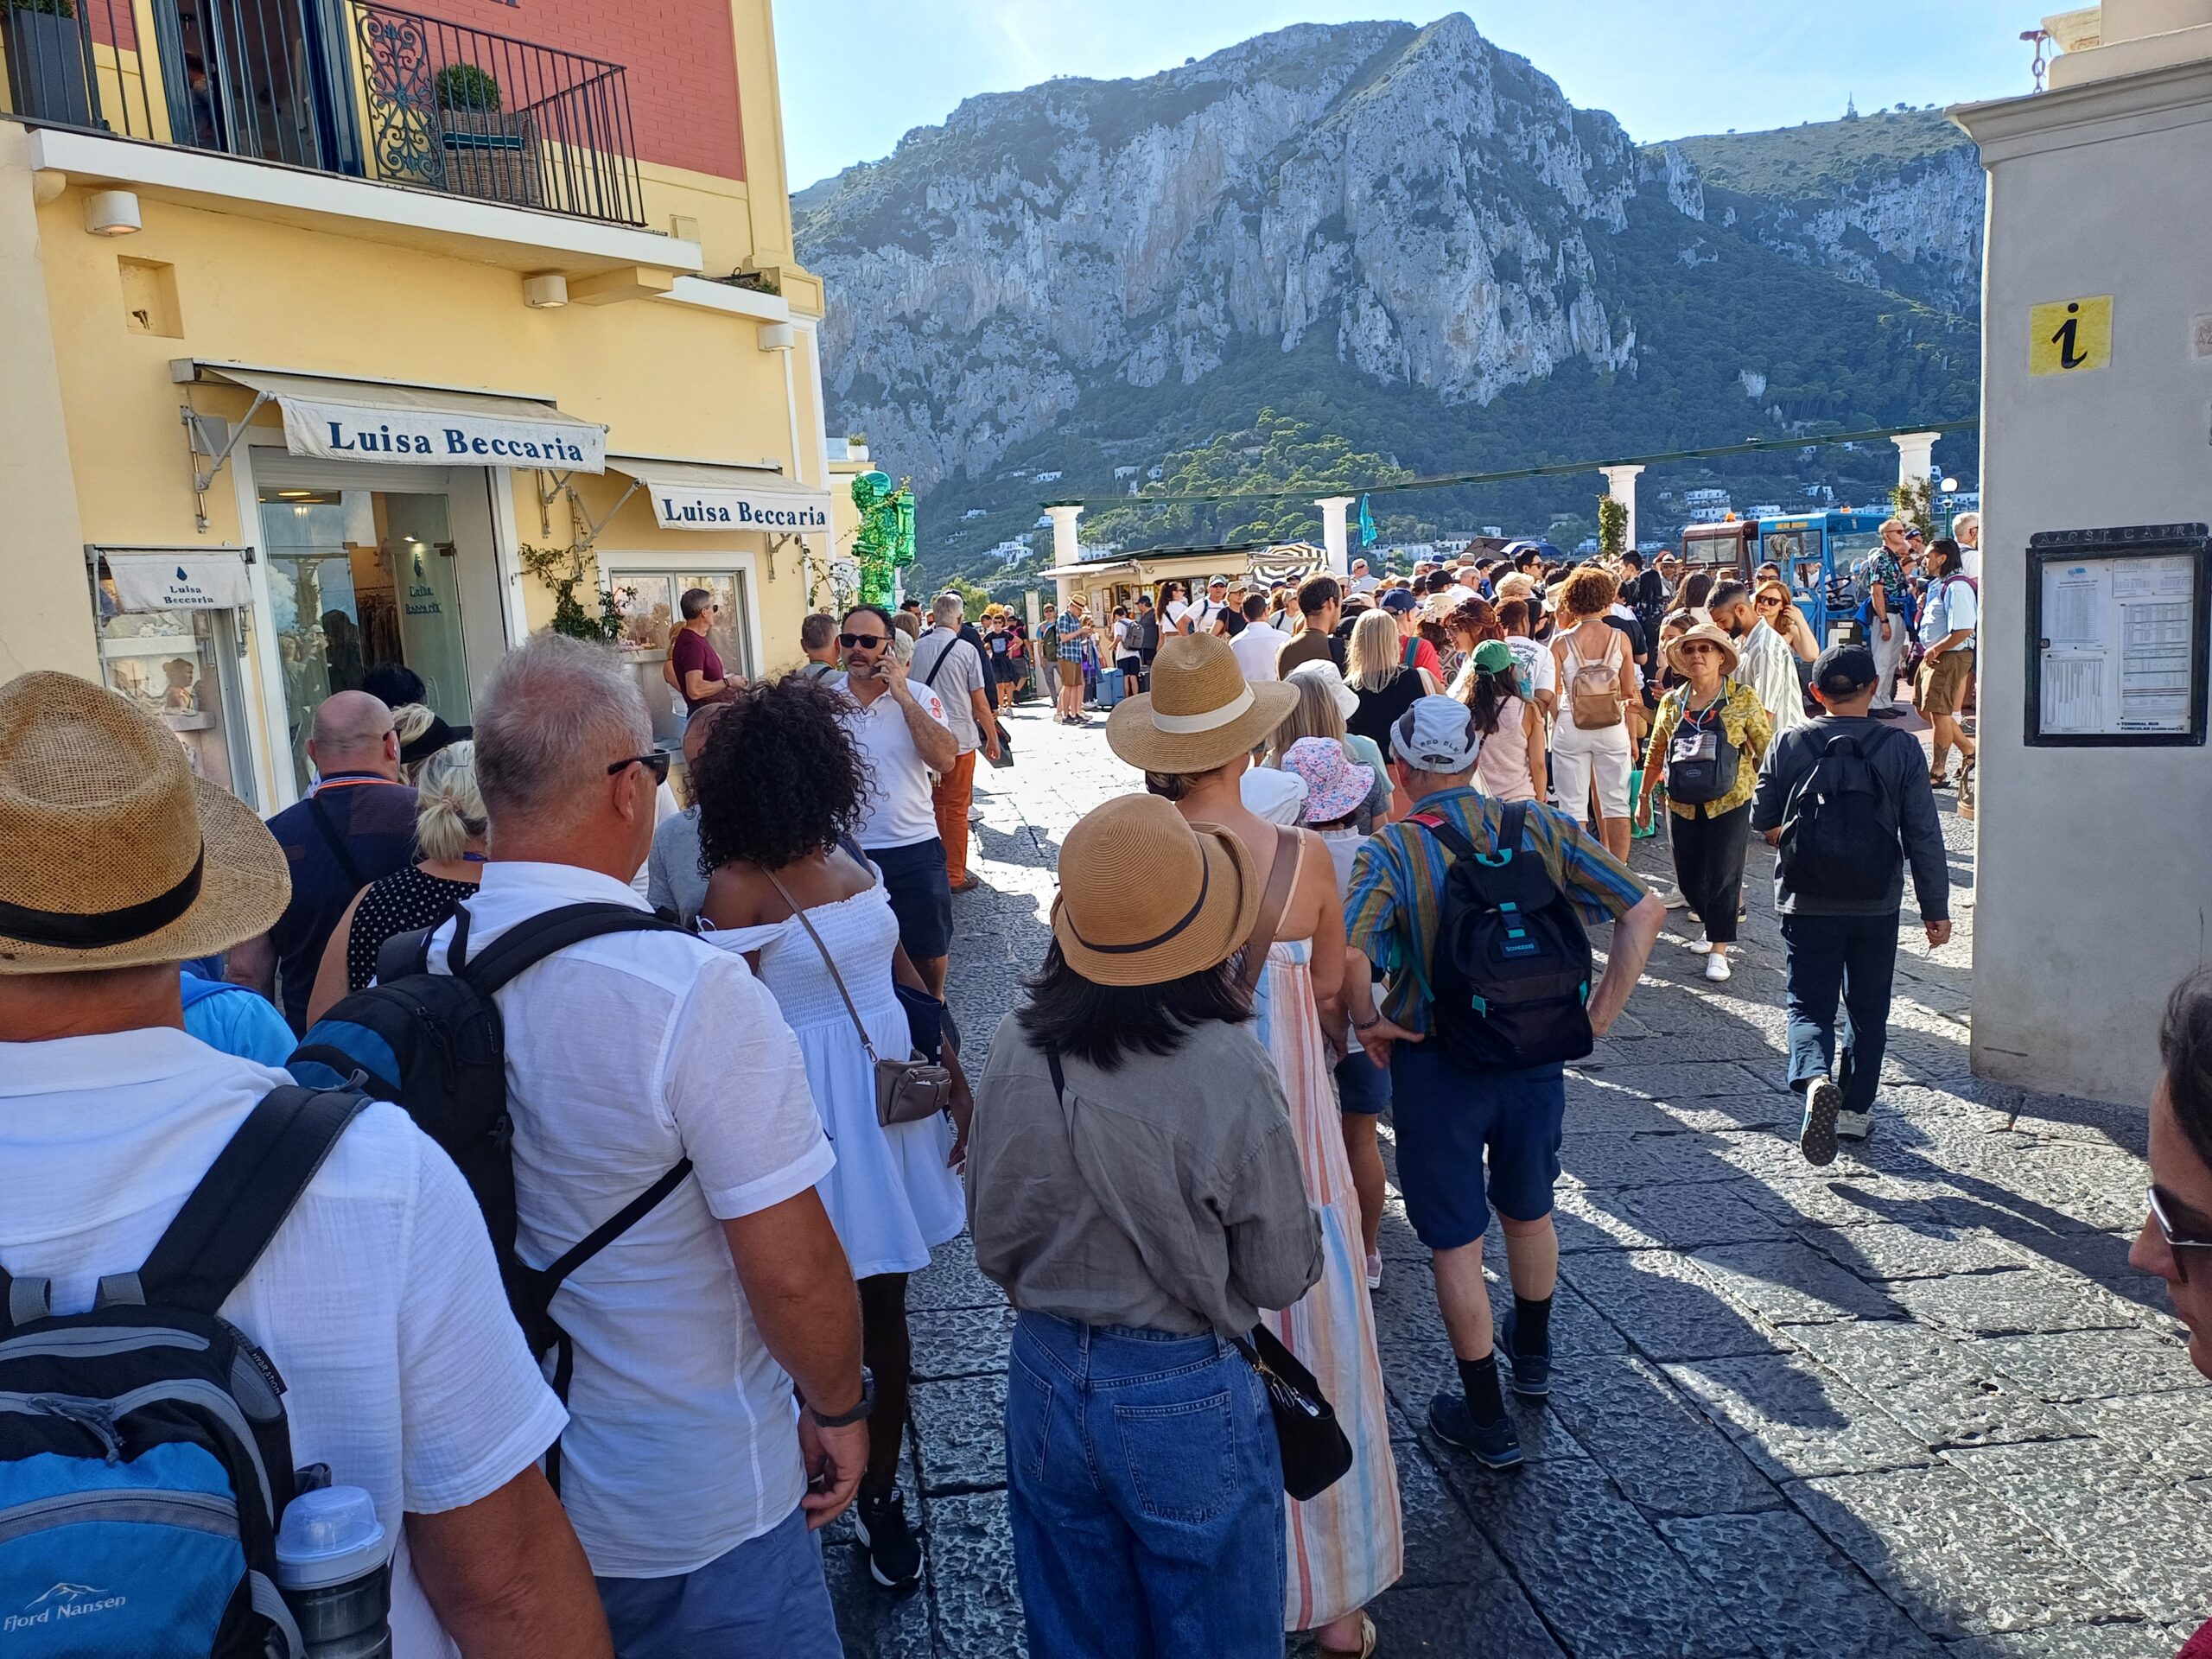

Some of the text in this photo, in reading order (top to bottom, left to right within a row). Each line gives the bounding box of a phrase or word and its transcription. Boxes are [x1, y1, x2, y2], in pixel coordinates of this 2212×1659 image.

[327, 421, 584, 461] Luisa Beccaria
[662, 499, 826, 525] Luisa Beccaria
[2124, 523, 2198, 540] CAPRI
[169, 585, 202, 594] Luisa
[251, 1352, 281, 1395] HYDRATION
[3, 1596, 126, 1632] Fjord Nansen
